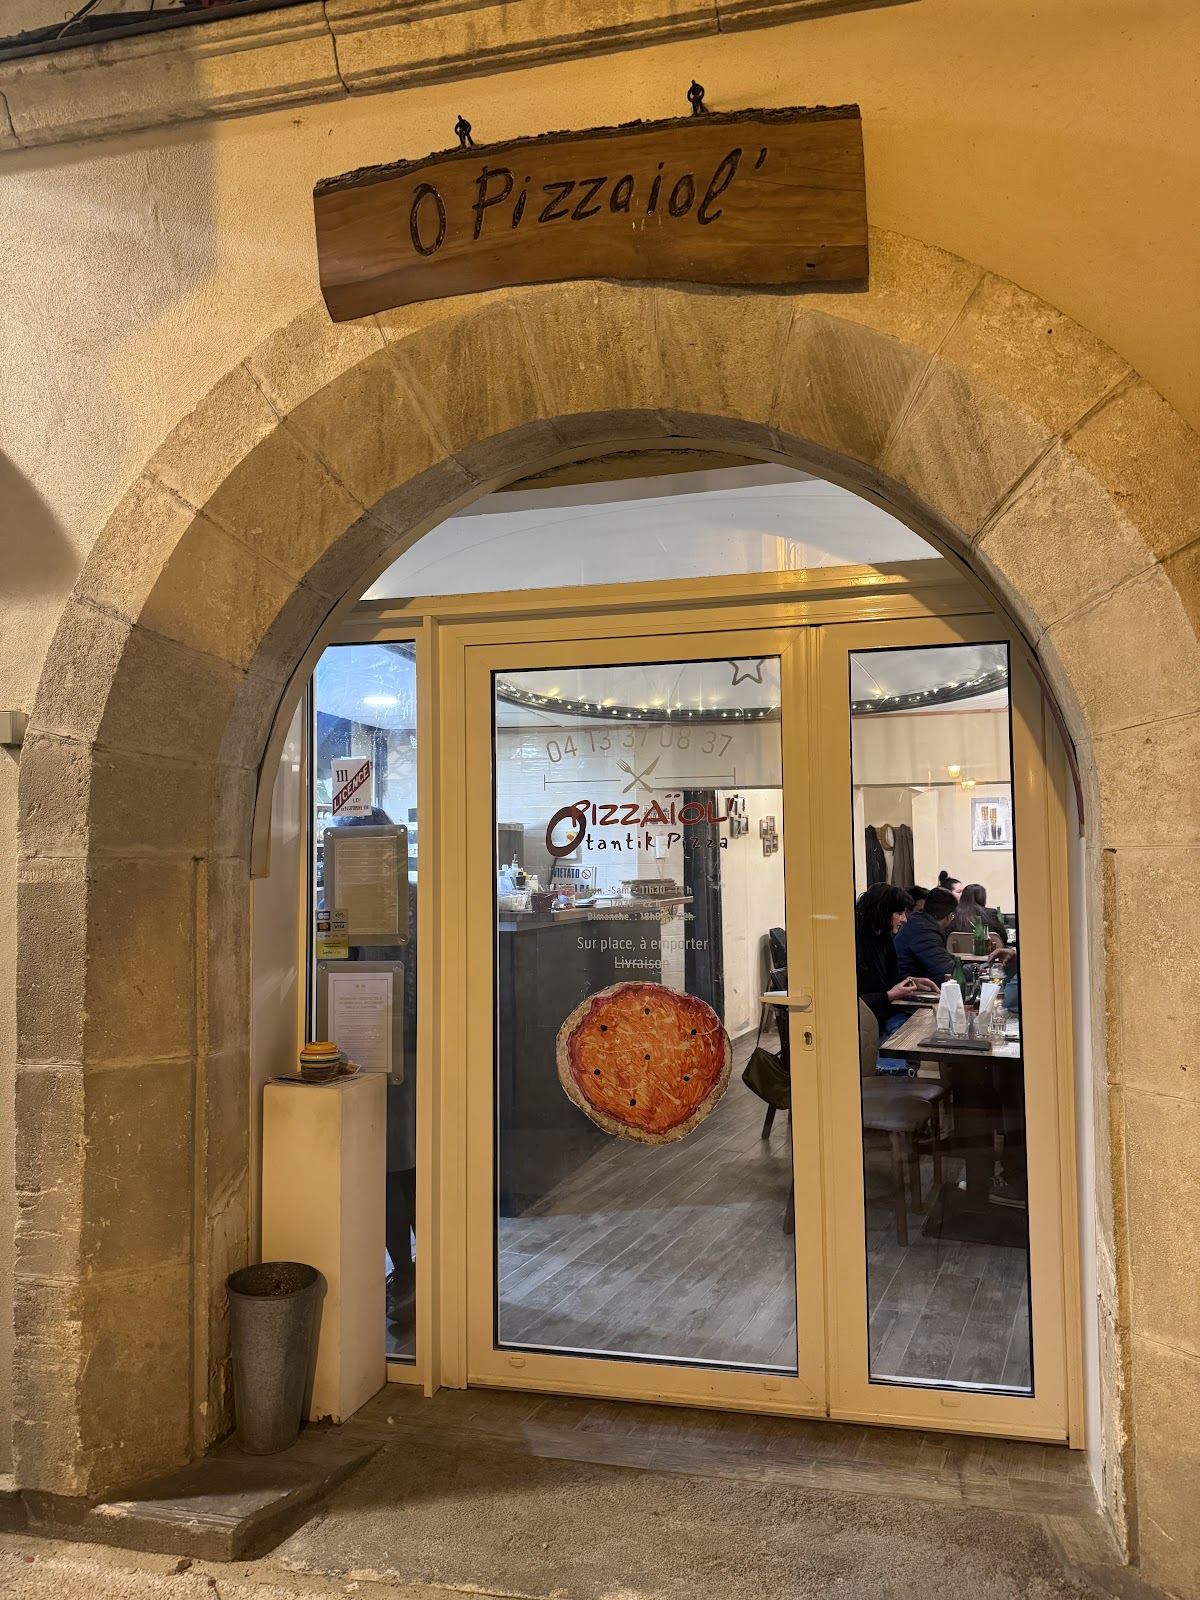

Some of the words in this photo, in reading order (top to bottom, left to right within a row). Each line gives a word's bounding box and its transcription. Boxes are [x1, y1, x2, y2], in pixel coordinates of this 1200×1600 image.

[409, 182, 447, 257] O
[472, 147, 768, 240] Pizzaiol'
[546, 735, 578, 763] 04
[585, 728, 612, 753] 13
[622, 725, 649, 748] 37
[659, 724, 692, 749] 08
[702, 731, 734, 757] 37
[335, 769, 349, 782] III
[333, 764, 369, 810] LICENCE
[667, 832, 728, 849] Pizza
[640, 885, 665, 895] 11h30
[577, 937, 597, 950] Sur
[600, 937, 636, 952] place,
[639, 936, 647, 950] à
[650, 937, 709, 953] emporter
